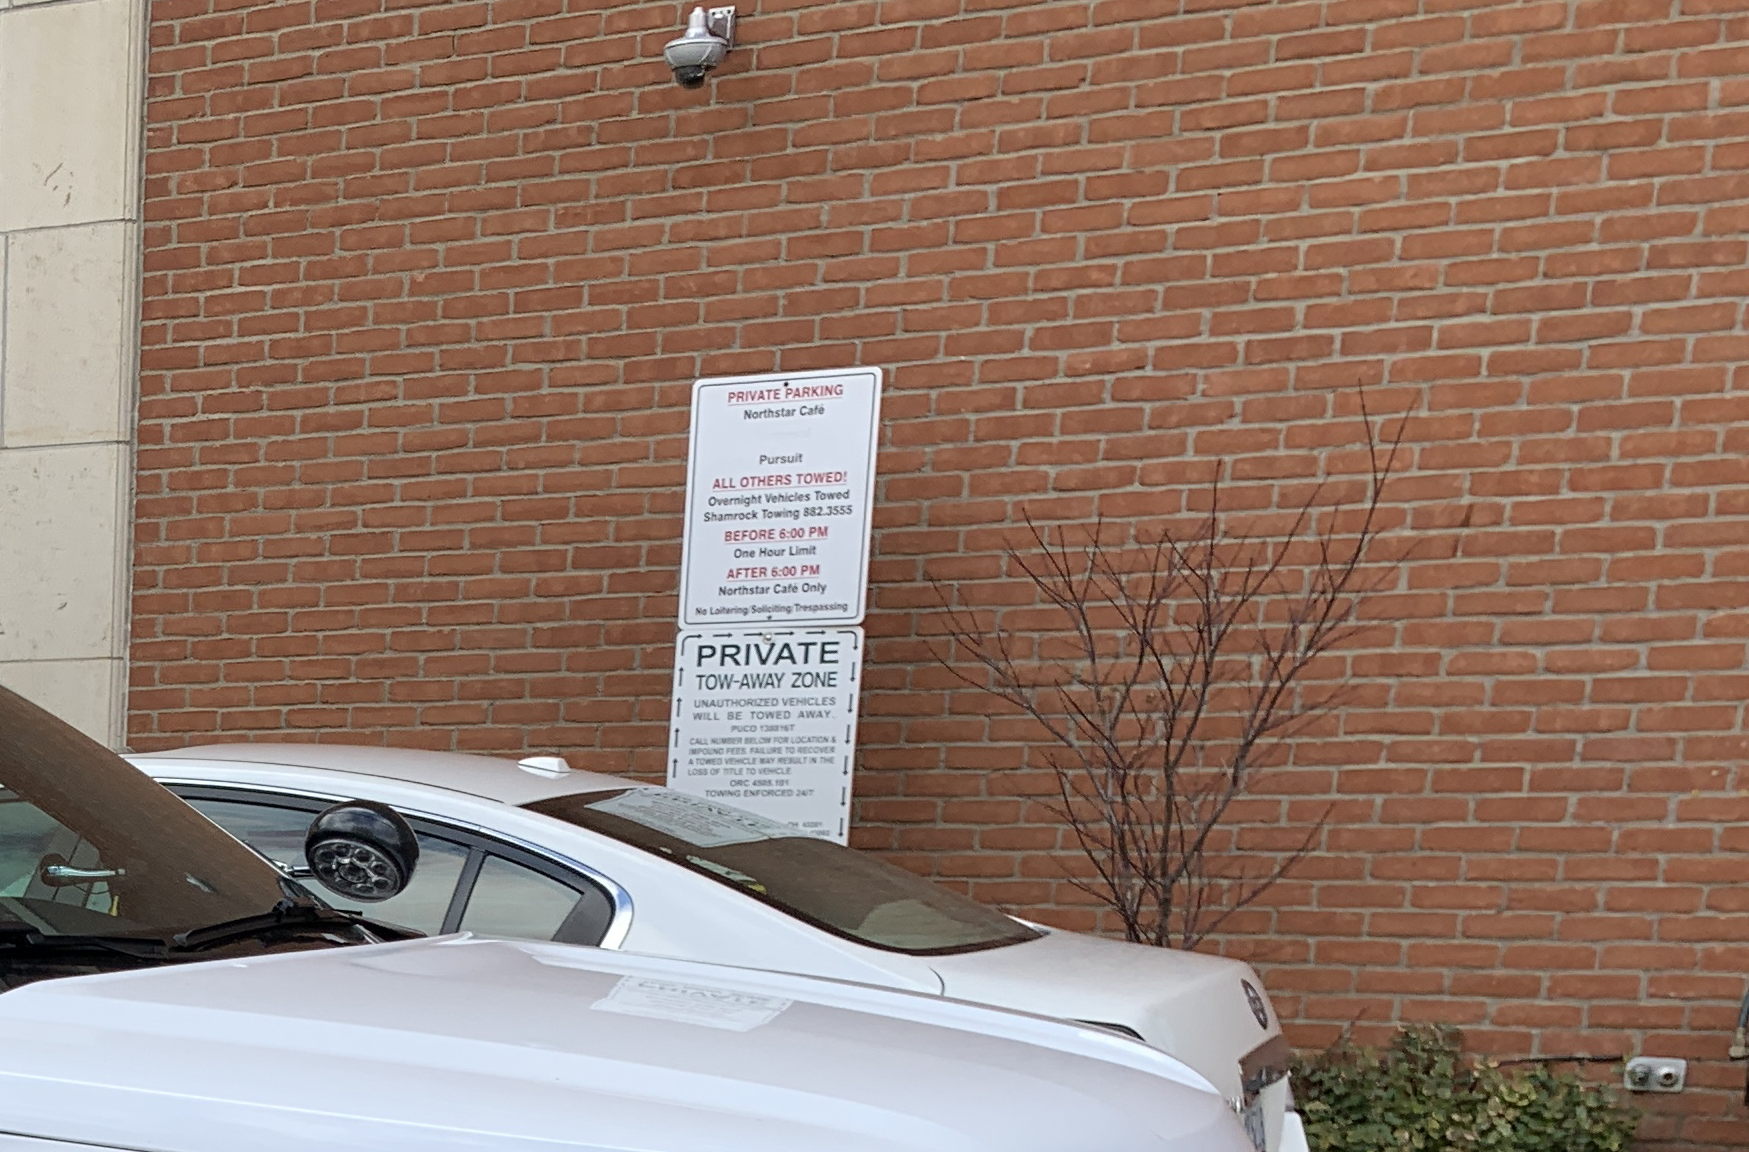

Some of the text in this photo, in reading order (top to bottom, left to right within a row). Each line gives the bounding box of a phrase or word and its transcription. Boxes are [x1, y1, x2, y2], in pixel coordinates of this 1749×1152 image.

[727, 384, 843, 402] PRIVATE PARKING
[743, 408, 796, 420] Northstar
[759, 453, 803, 464] Pursuit
[713, 471, 847, 489] ALL OTHERS TOWED!
[709, 490, 850, 507] Overnight Vehicles Towed
[703, 505, 853, 522] Shamrock Towing 882.3555
[725, 526, 829, 542] BEFORE 6:00 PM
[733, 545, 817, 558] One Hour Limit
[727, 567, 767, 579] AFTER
[801, 564, 821, 576] PM
[718, 584, 771, 596] Northstar
[802, 582, 827, 594] Only
[695, 606, 707, 615] No
[697, 642, 840, 668] PRIVATE
[696, 672, 838, 690] TOW-AWAY ZONE
[693, 696, 837, 708] UNAUTHORIZED VEHICLES
[693, 710, 836, 720] WILL BE TOWED AWAY.
[711, 737, 743, 745] NUMBER
[744, 736, 771, 744] BELOW
[773, 736, 789, 744] FOR
[791, 736, 829, 744] LOCATION
[749, 747, 783, 755] FAILURE
[785, 746, 795, 754] TO
[797, 746, 835, 754] RECOVER
[724, 757, 757, 765] VEHICLE
[809, 756, 817, 764] IN
[819, 756, 835, 764] THE
[687, 768, 708, 776] LOSS
[710, 768, 720, 776] OF
[730, 779, 750, 787] ORC
[705, 789, 741, 798] TOWING
[743, 789, 793, 797] ENFORCED
